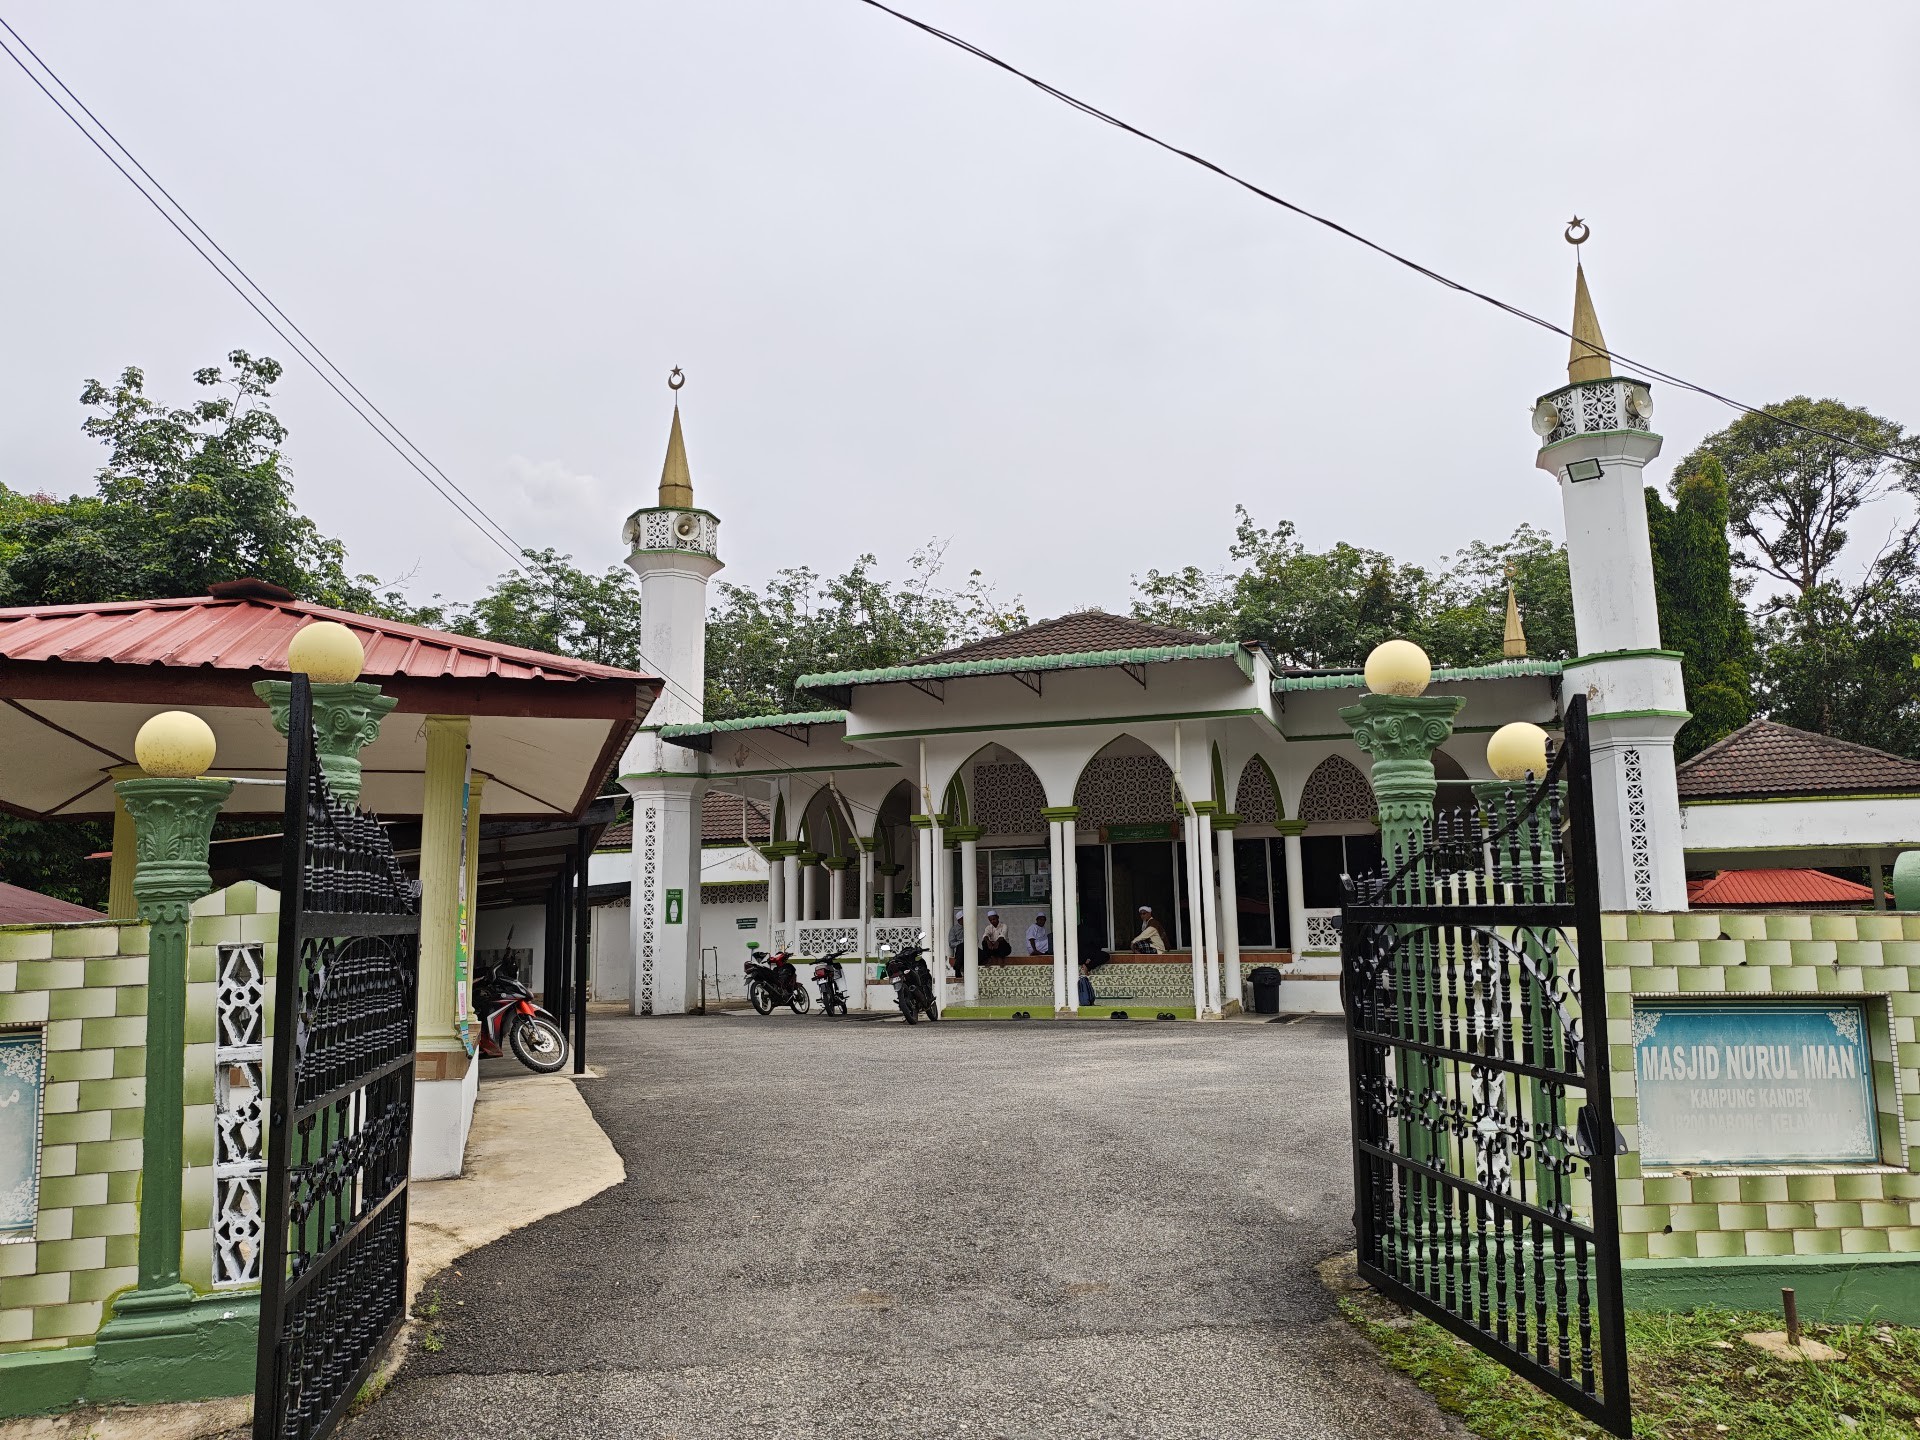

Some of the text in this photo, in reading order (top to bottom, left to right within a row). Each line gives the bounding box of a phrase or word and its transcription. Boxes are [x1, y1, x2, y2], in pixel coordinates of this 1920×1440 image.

[1642, 1045, 1856, 1080] MASJID NURUL IMAN
[1690, 1087, 1812, 1109] KAMPUNG KANDEK
